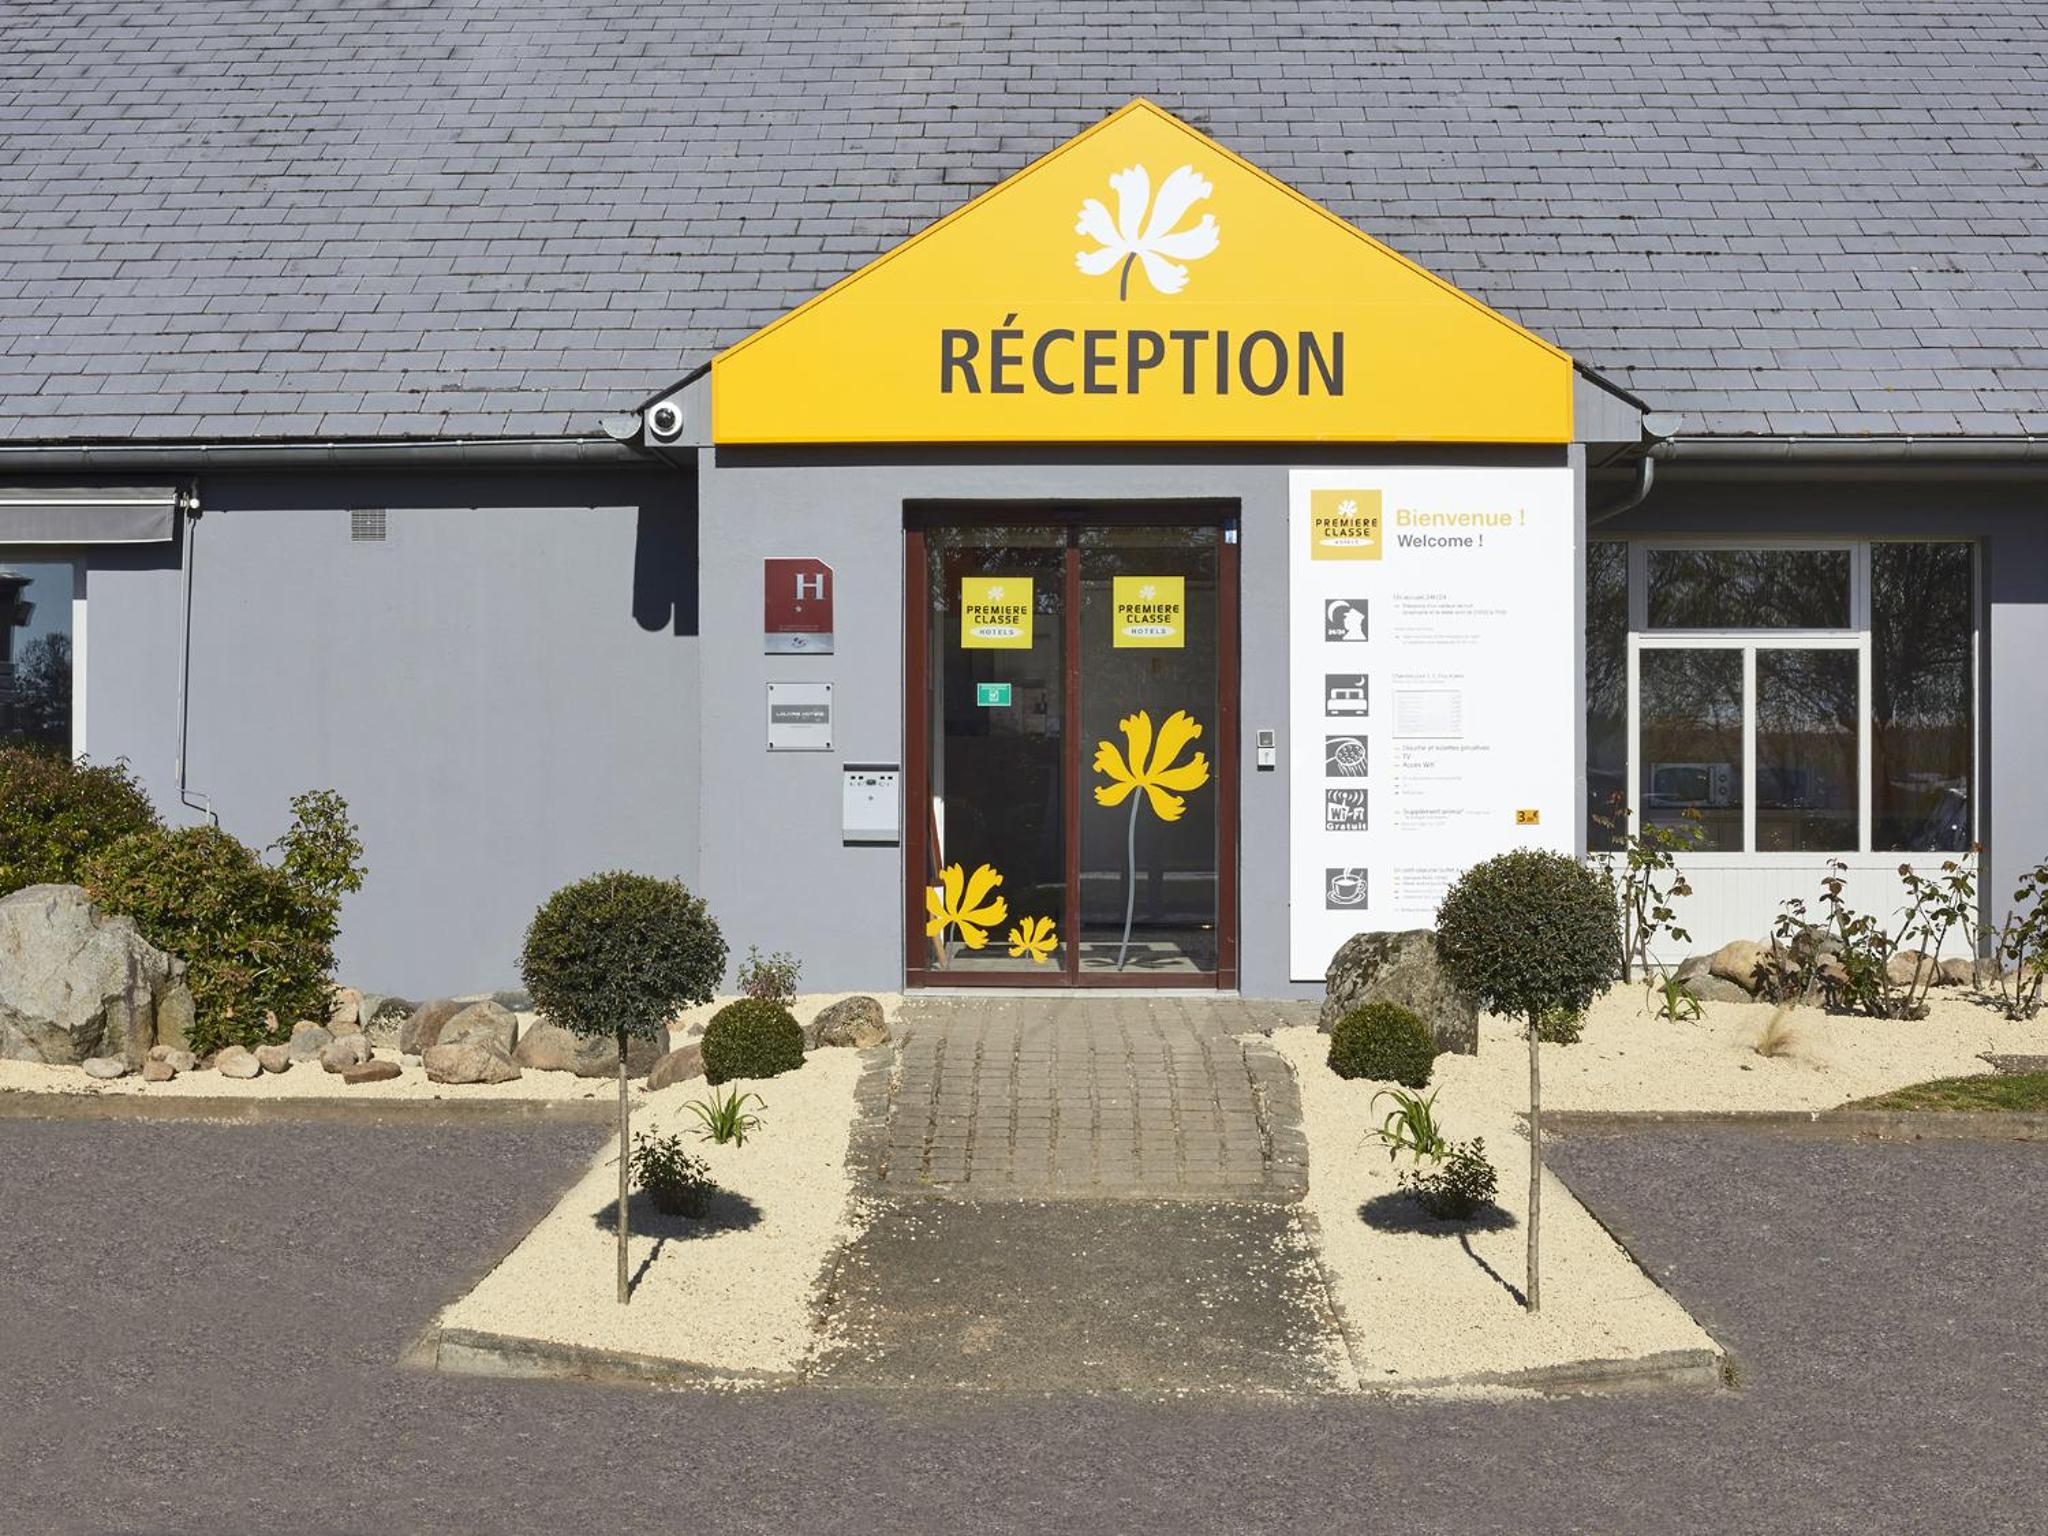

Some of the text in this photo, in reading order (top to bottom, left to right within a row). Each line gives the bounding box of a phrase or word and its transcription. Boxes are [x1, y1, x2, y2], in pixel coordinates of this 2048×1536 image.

[940, 313, 1344, 396] RÉCEPTION
[1315, 518, 1377, 527] PREMIERE
[1396, 508, 1525, 527] Bienvenue !
[1324, 528, 1370, 537] CLASSE
[1397, 534, 1483, 548] Welcome !
[796, 574, 823, 600] H
[966, 605, 1028, 615] PREMIERE
[1118, 604, 1180, 614] PREMIERE
[974, 615, 1021, 625] CLASSE
[1126, 614, 1172, 624] CLASSE
[979, 628, 1015, 636] HOTELS
[1131, 627, 1167, 635] HOTELS
